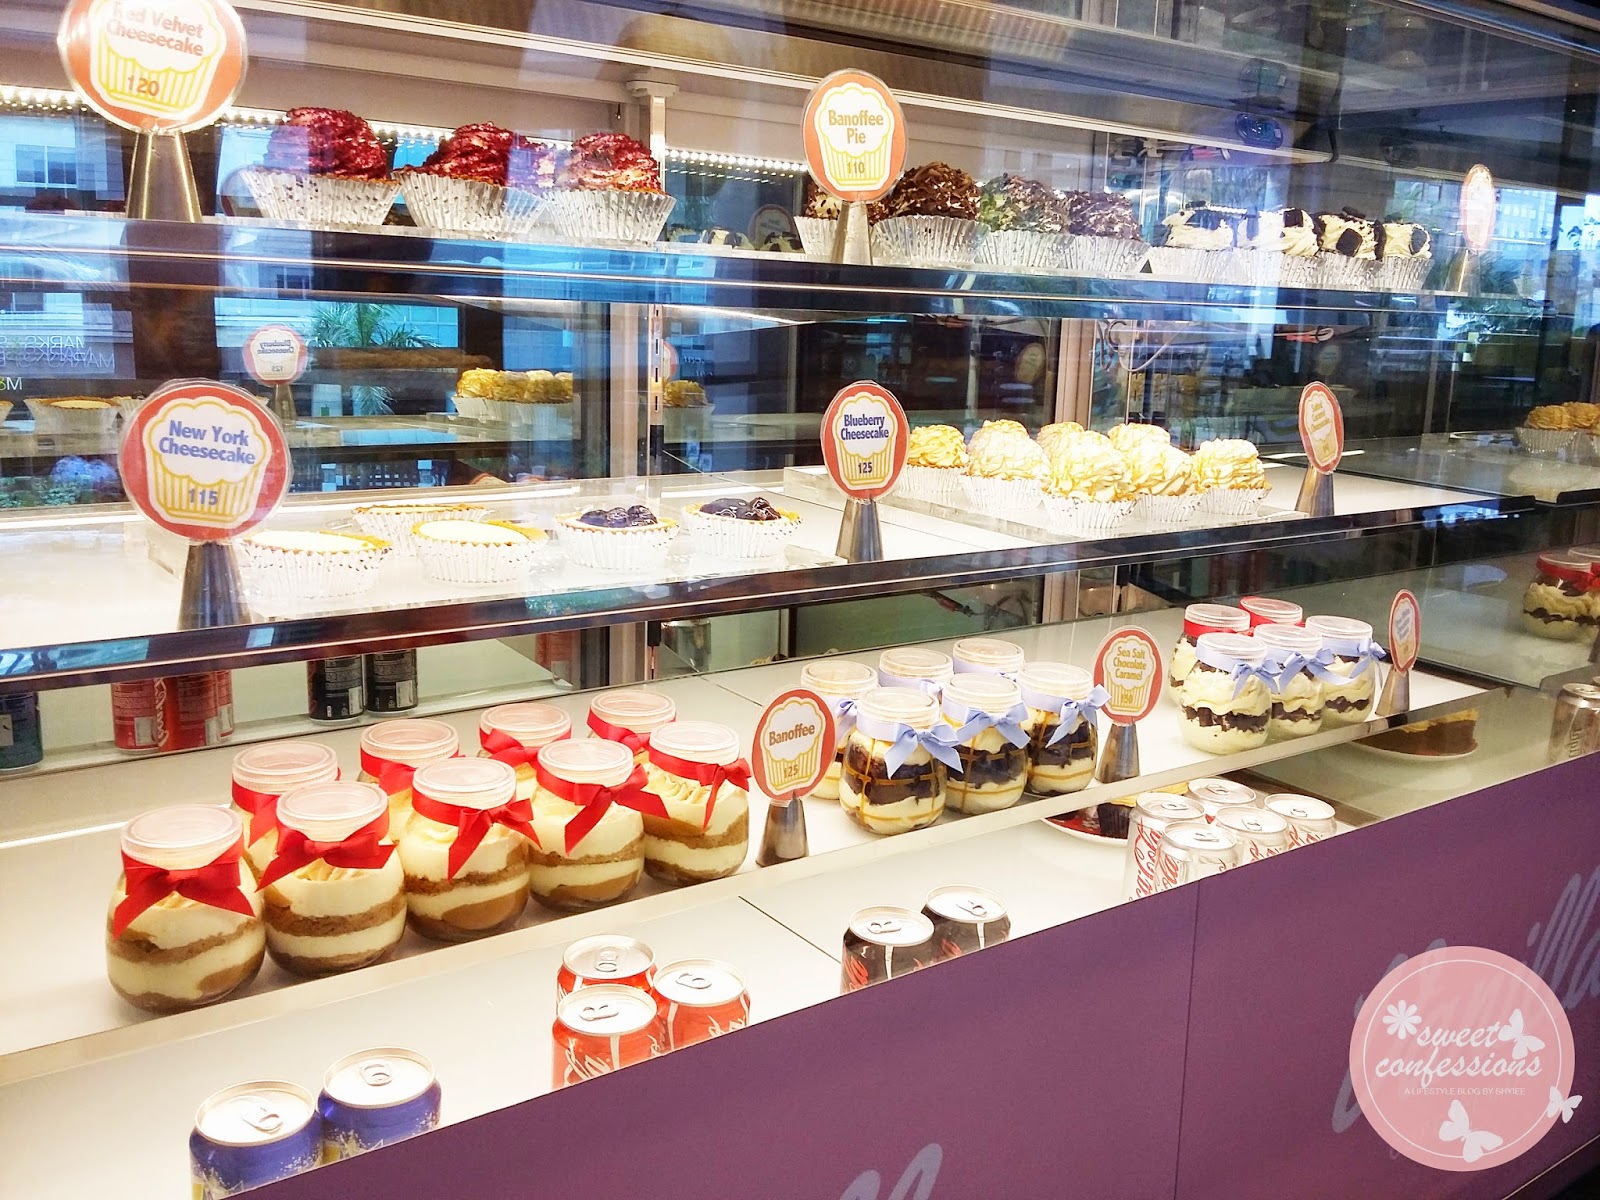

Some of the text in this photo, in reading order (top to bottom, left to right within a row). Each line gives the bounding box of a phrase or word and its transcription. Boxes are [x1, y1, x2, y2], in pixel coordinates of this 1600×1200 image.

[152, 8, 204, 39] Velvet
[107, 19, 204, 57] Cheesecake
[128, 75, 160, 97] 120
[828, 109, 884, 126] Banoffee
[846, 128, 867, 144] Pie
[846, 162, 866, 174] 110
[843, 414, 885, 429] Blueberry
[169, 420, 248, 446] New York
[840, 427, 889, 441] Cheesecake
[159, 436, 255, 464] Cheesecake
[858, 461, 873, 474] 125
[189, 488, 218, 506] 115
[1117, 646, 1146, 659] Sea Salt
[1113, 657, 1147, 670] Chocolate
[1115, 668, 1143, 680] Caramel
[769, 722, 816, 747] Banoffee
[784, 764, 799, 778] 125
